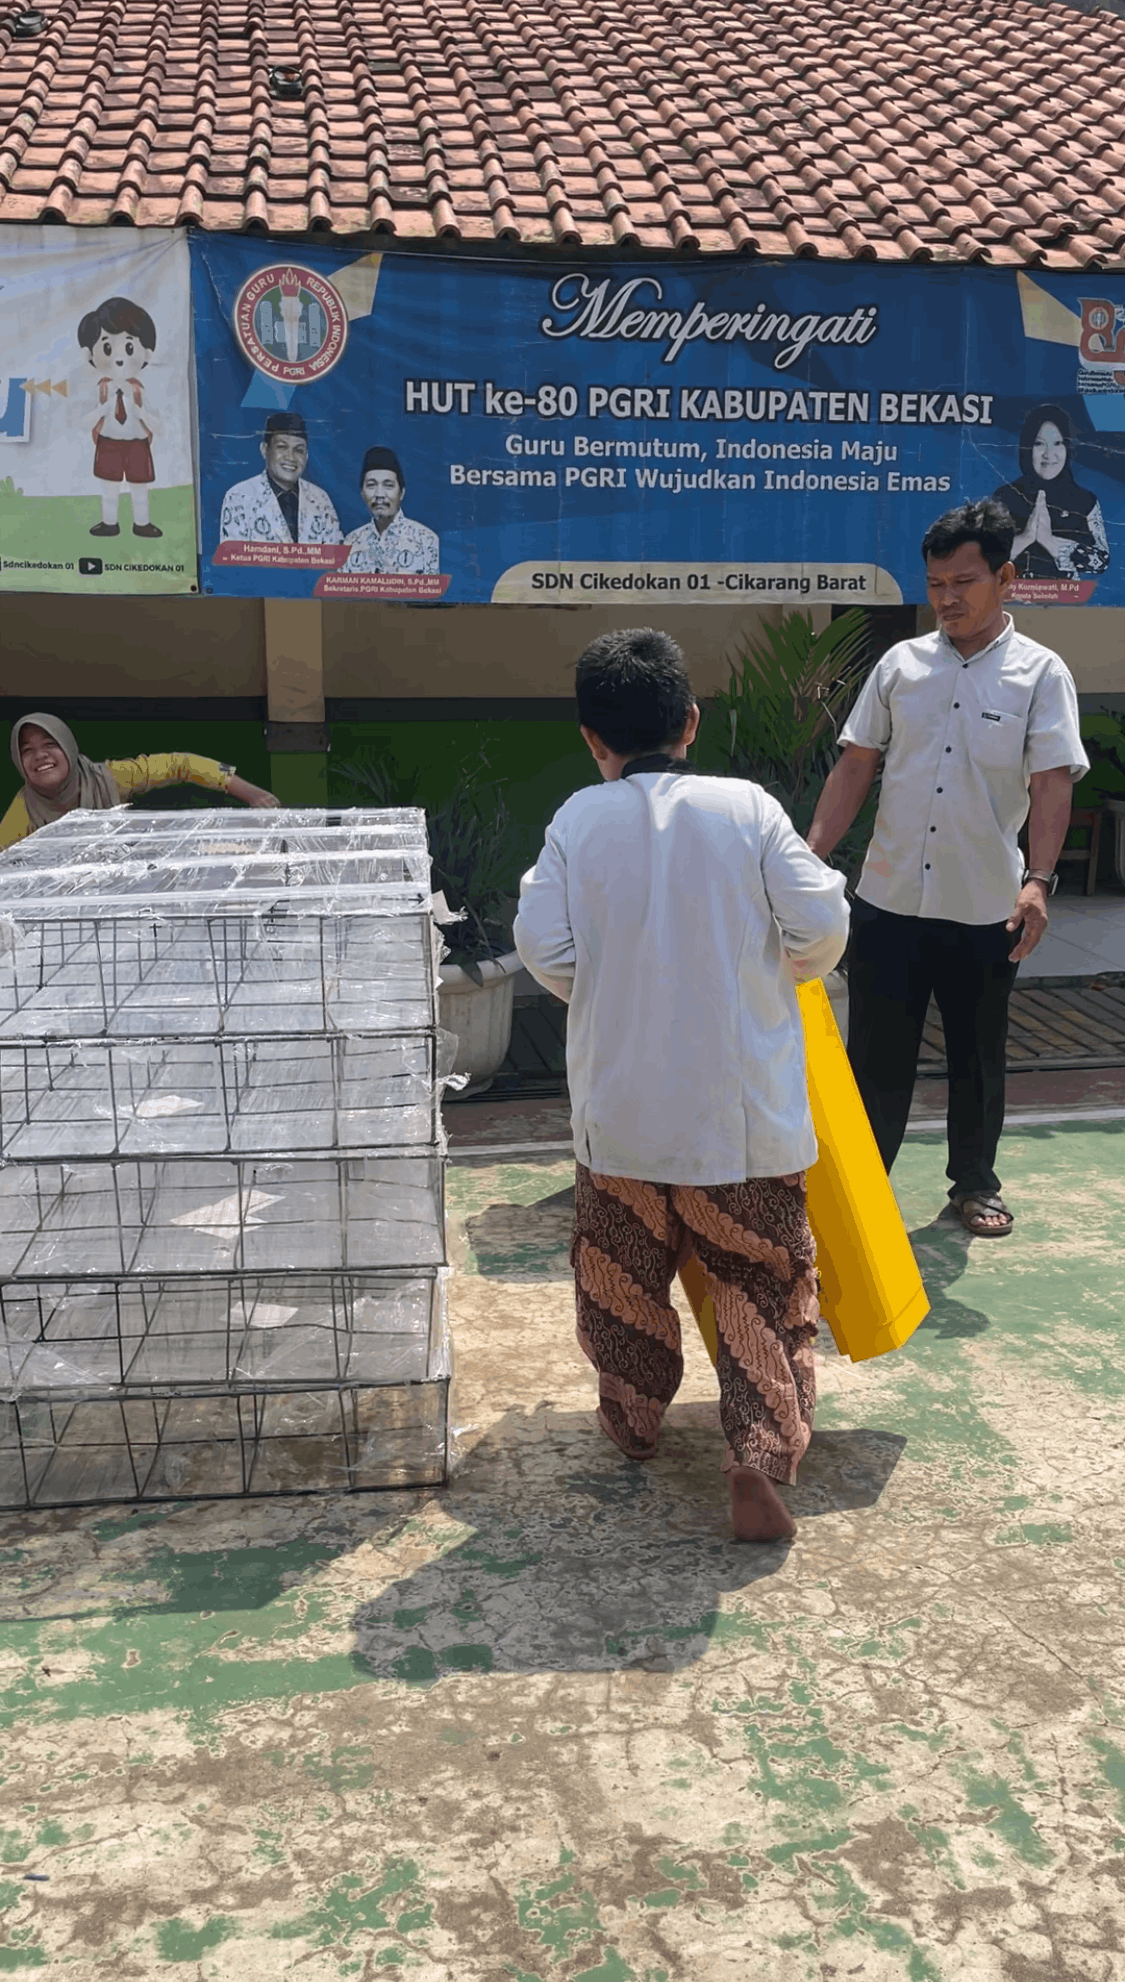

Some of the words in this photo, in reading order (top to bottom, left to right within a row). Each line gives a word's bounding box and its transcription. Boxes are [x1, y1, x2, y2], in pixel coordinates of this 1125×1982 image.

[246, 273, 276, 301] GURU
[306, 276, 341, 323] REPUBLIK
[541, 272, 877, 369] Memperingati
[240, 303, 280, 373] PERSATUAN
[308, 324, 342, 372] INDONESIA
[282, 366, 306, 376] PGRI
[405, 380, 476, 414] HUT
[485, 382, 579, 418] ke-80
[588, 386, 671, 419] PGRI
[680, 388, 869, 422] KABUPATEN
[879, 393, 994, 425] BEKASI
[505, 433, 565, 456] Guru
[573, 435, 708, 463] Bermutum,
[715, 438, 834, 461] Indonesia
[841, 440, 898, 466] Maju
[450, 464, 557, 487] Bersama
[564, 466, 627, 488] PGRI
[634, 467, 756, 493] Wujudkan
[763, 469, 880, 492] Indonesia
[886, 471, 951, 493] Emas
[230, 553, 252, 562] Ketua
[253, 554, 271, 562] PGRI
[272, 555, 310, 565] Kabupaten
[311, 556, 335, 565] Bekasi
[243, 544, 281, 555] Hamdani,
[65, 561, 74, 570] 01
[104, 563, 122, 571] SDN
[124, 563, 173, 572] CIKEDOKAN
[175, 564, 184, 572] 01
[323, 584, 359, 593] Sekretaris
[360, 585, 378, 593] PGRI
[380, 586, 417, 594] Kabupaten
[418, 586, 442, 594] Bekasi
[325, 576, 359, 585] KARMAN
[531, 572, 574, 590] SDN
[579, 572, 681, 591] Cikedokan
[686, 573, 711, 590] 01
[816, 575, 867, 591] Barat
